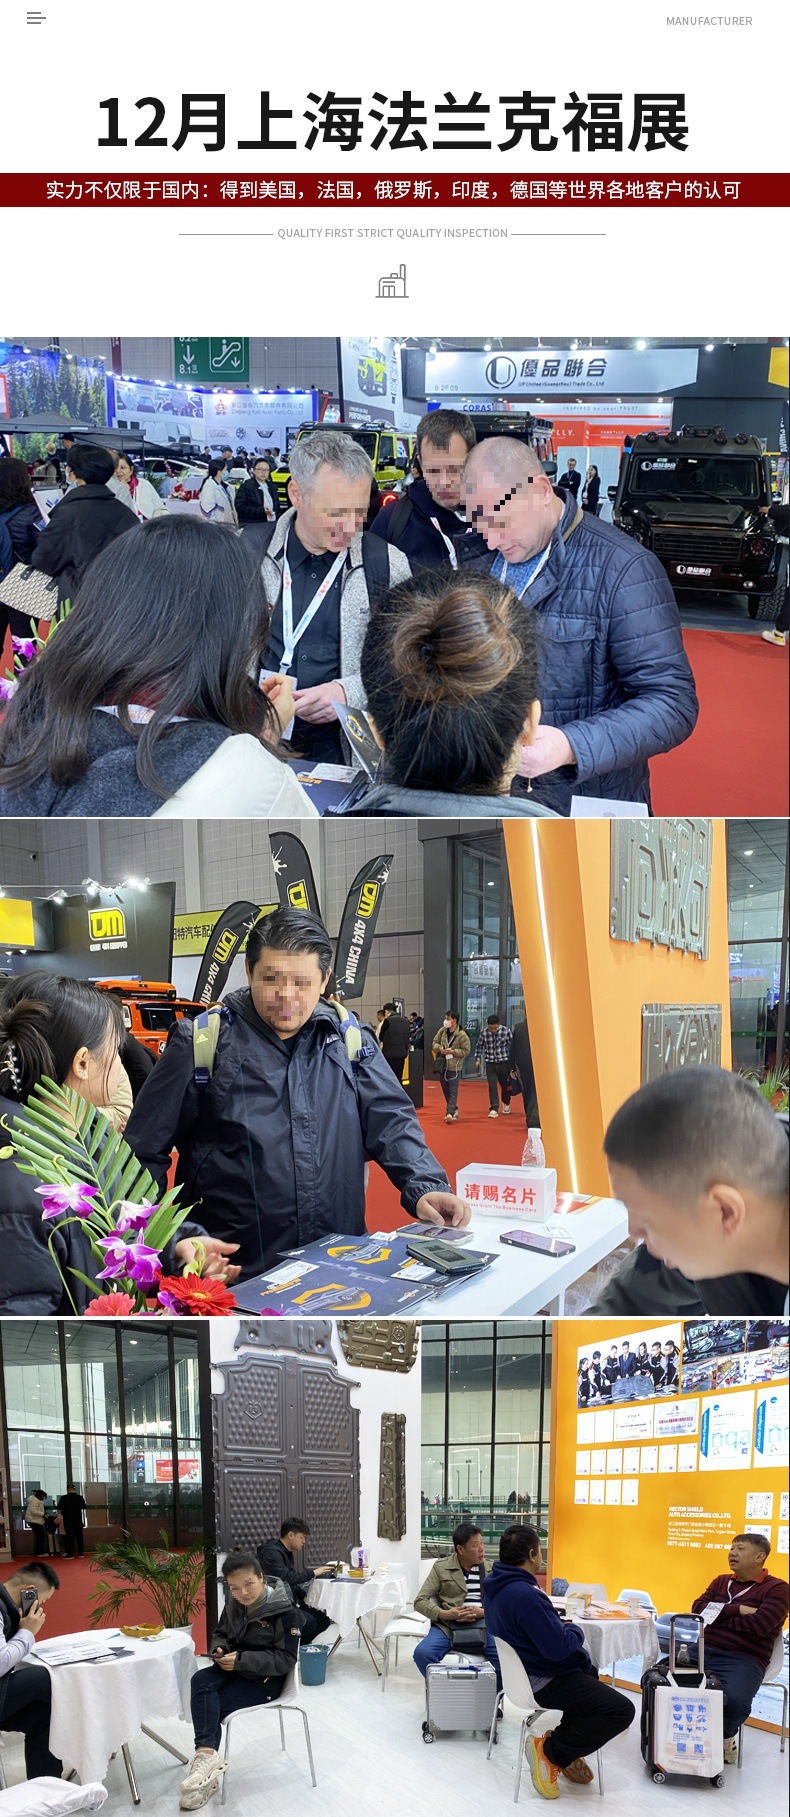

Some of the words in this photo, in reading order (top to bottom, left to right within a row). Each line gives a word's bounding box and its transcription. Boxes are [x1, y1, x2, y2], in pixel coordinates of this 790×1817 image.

[520, 358, 607, 377] 優品聯合
[345, 945, 362, 985] CHINA
[464, 1183, 537, 1206] 请赐名片
